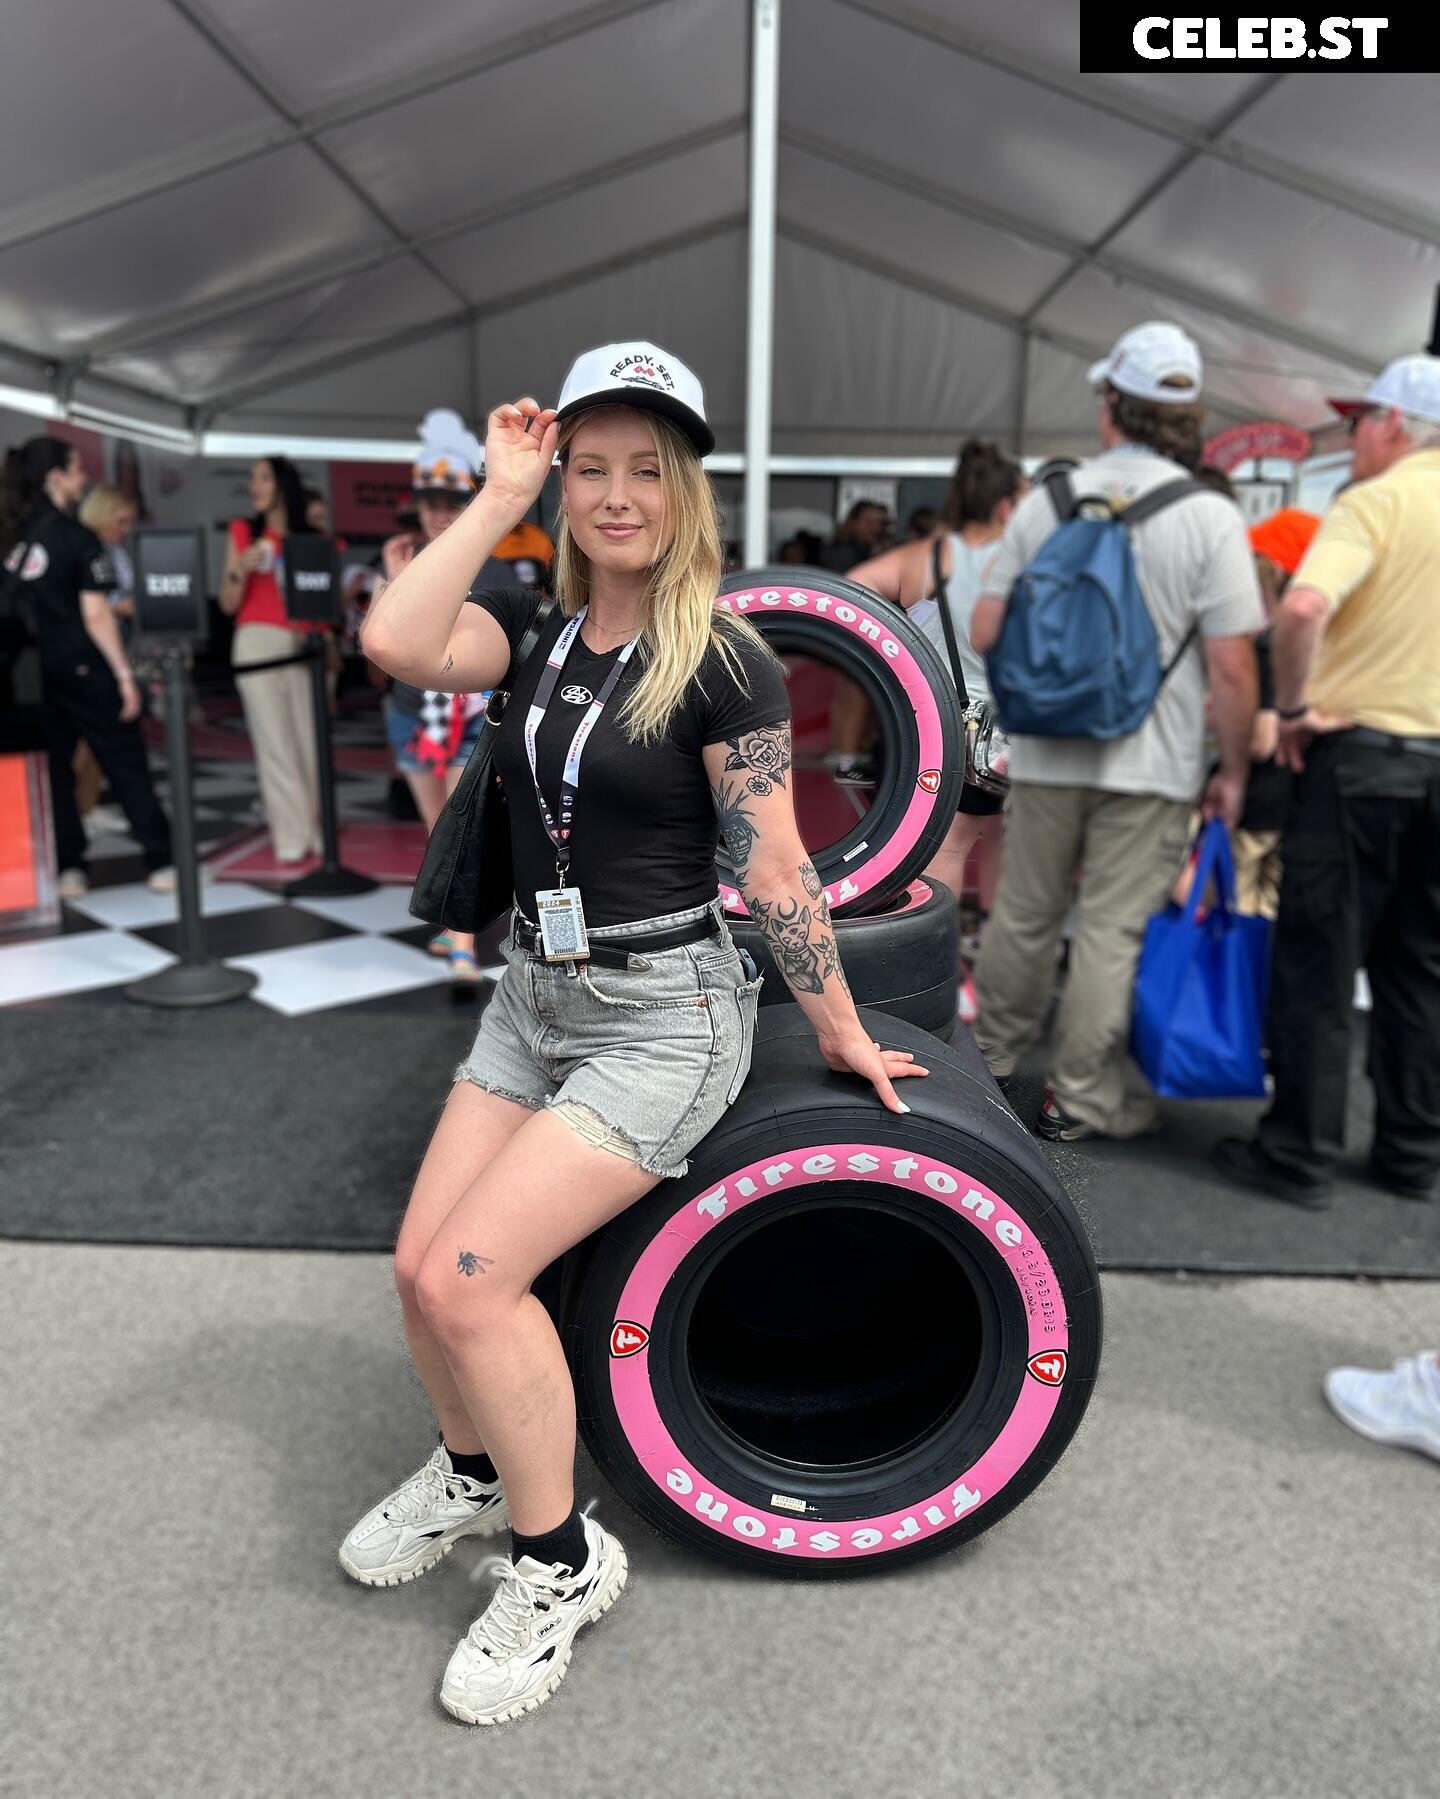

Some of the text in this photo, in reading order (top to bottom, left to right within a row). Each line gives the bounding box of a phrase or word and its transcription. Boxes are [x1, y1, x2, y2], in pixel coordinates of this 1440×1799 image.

[609, 354, 675, 391] READY. SET.
[696, 1152, 1023, 1247] Firestone
[666, 1467, 982, 1552] Firestone
